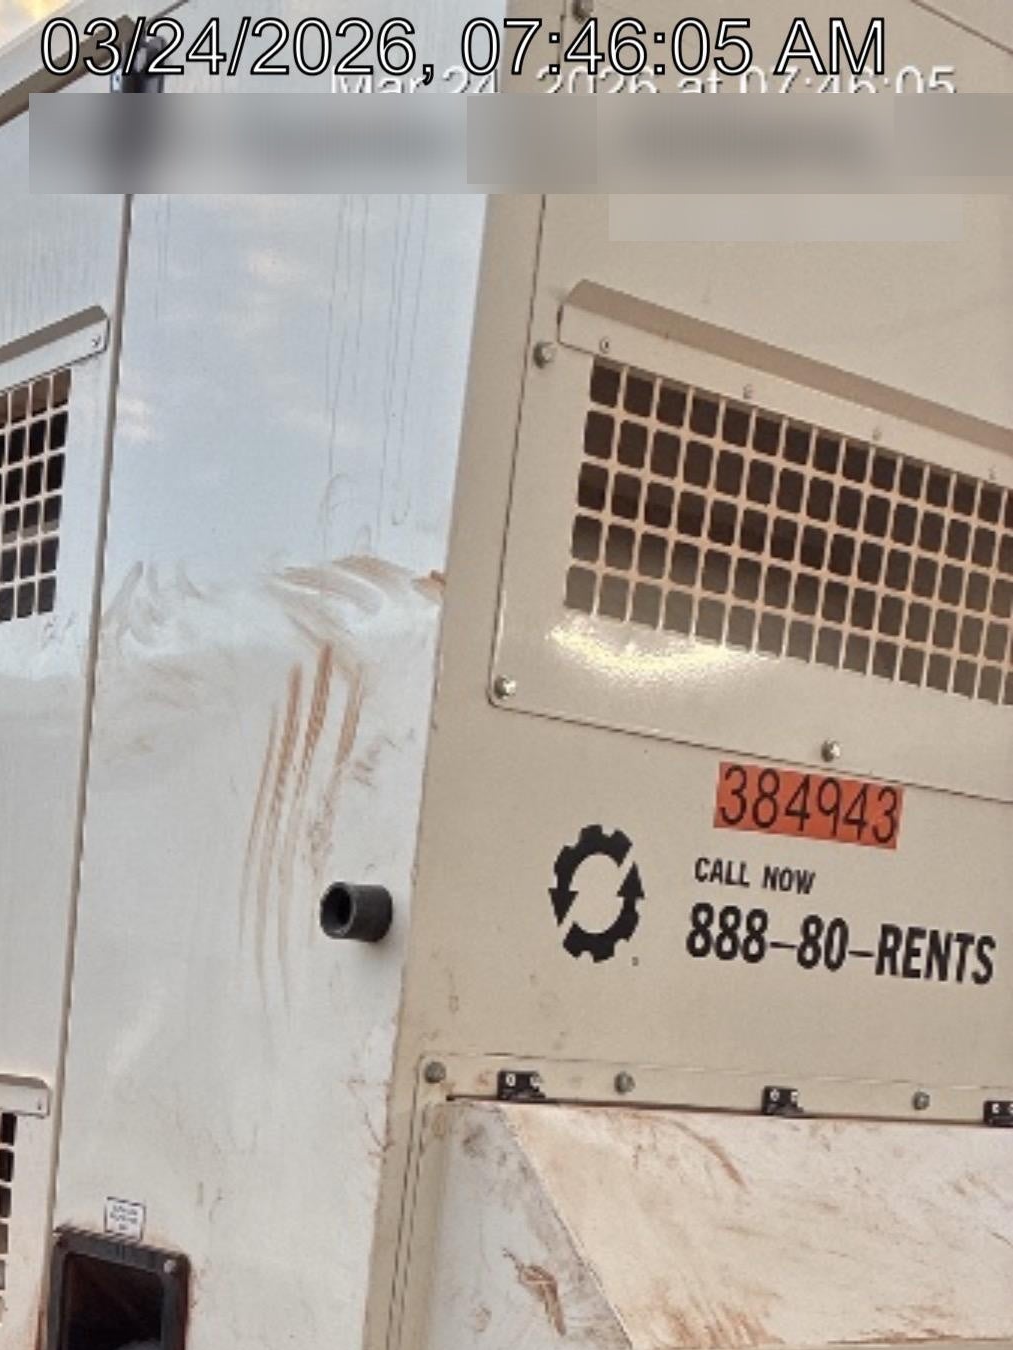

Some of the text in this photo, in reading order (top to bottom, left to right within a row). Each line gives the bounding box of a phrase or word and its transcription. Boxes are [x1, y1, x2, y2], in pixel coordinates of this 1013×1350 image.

[720, 765, 898, 843] 384943
[695, 857, 816, 894] CALL NOW
[686, 902, 997, 985] 888-80-RENTS
